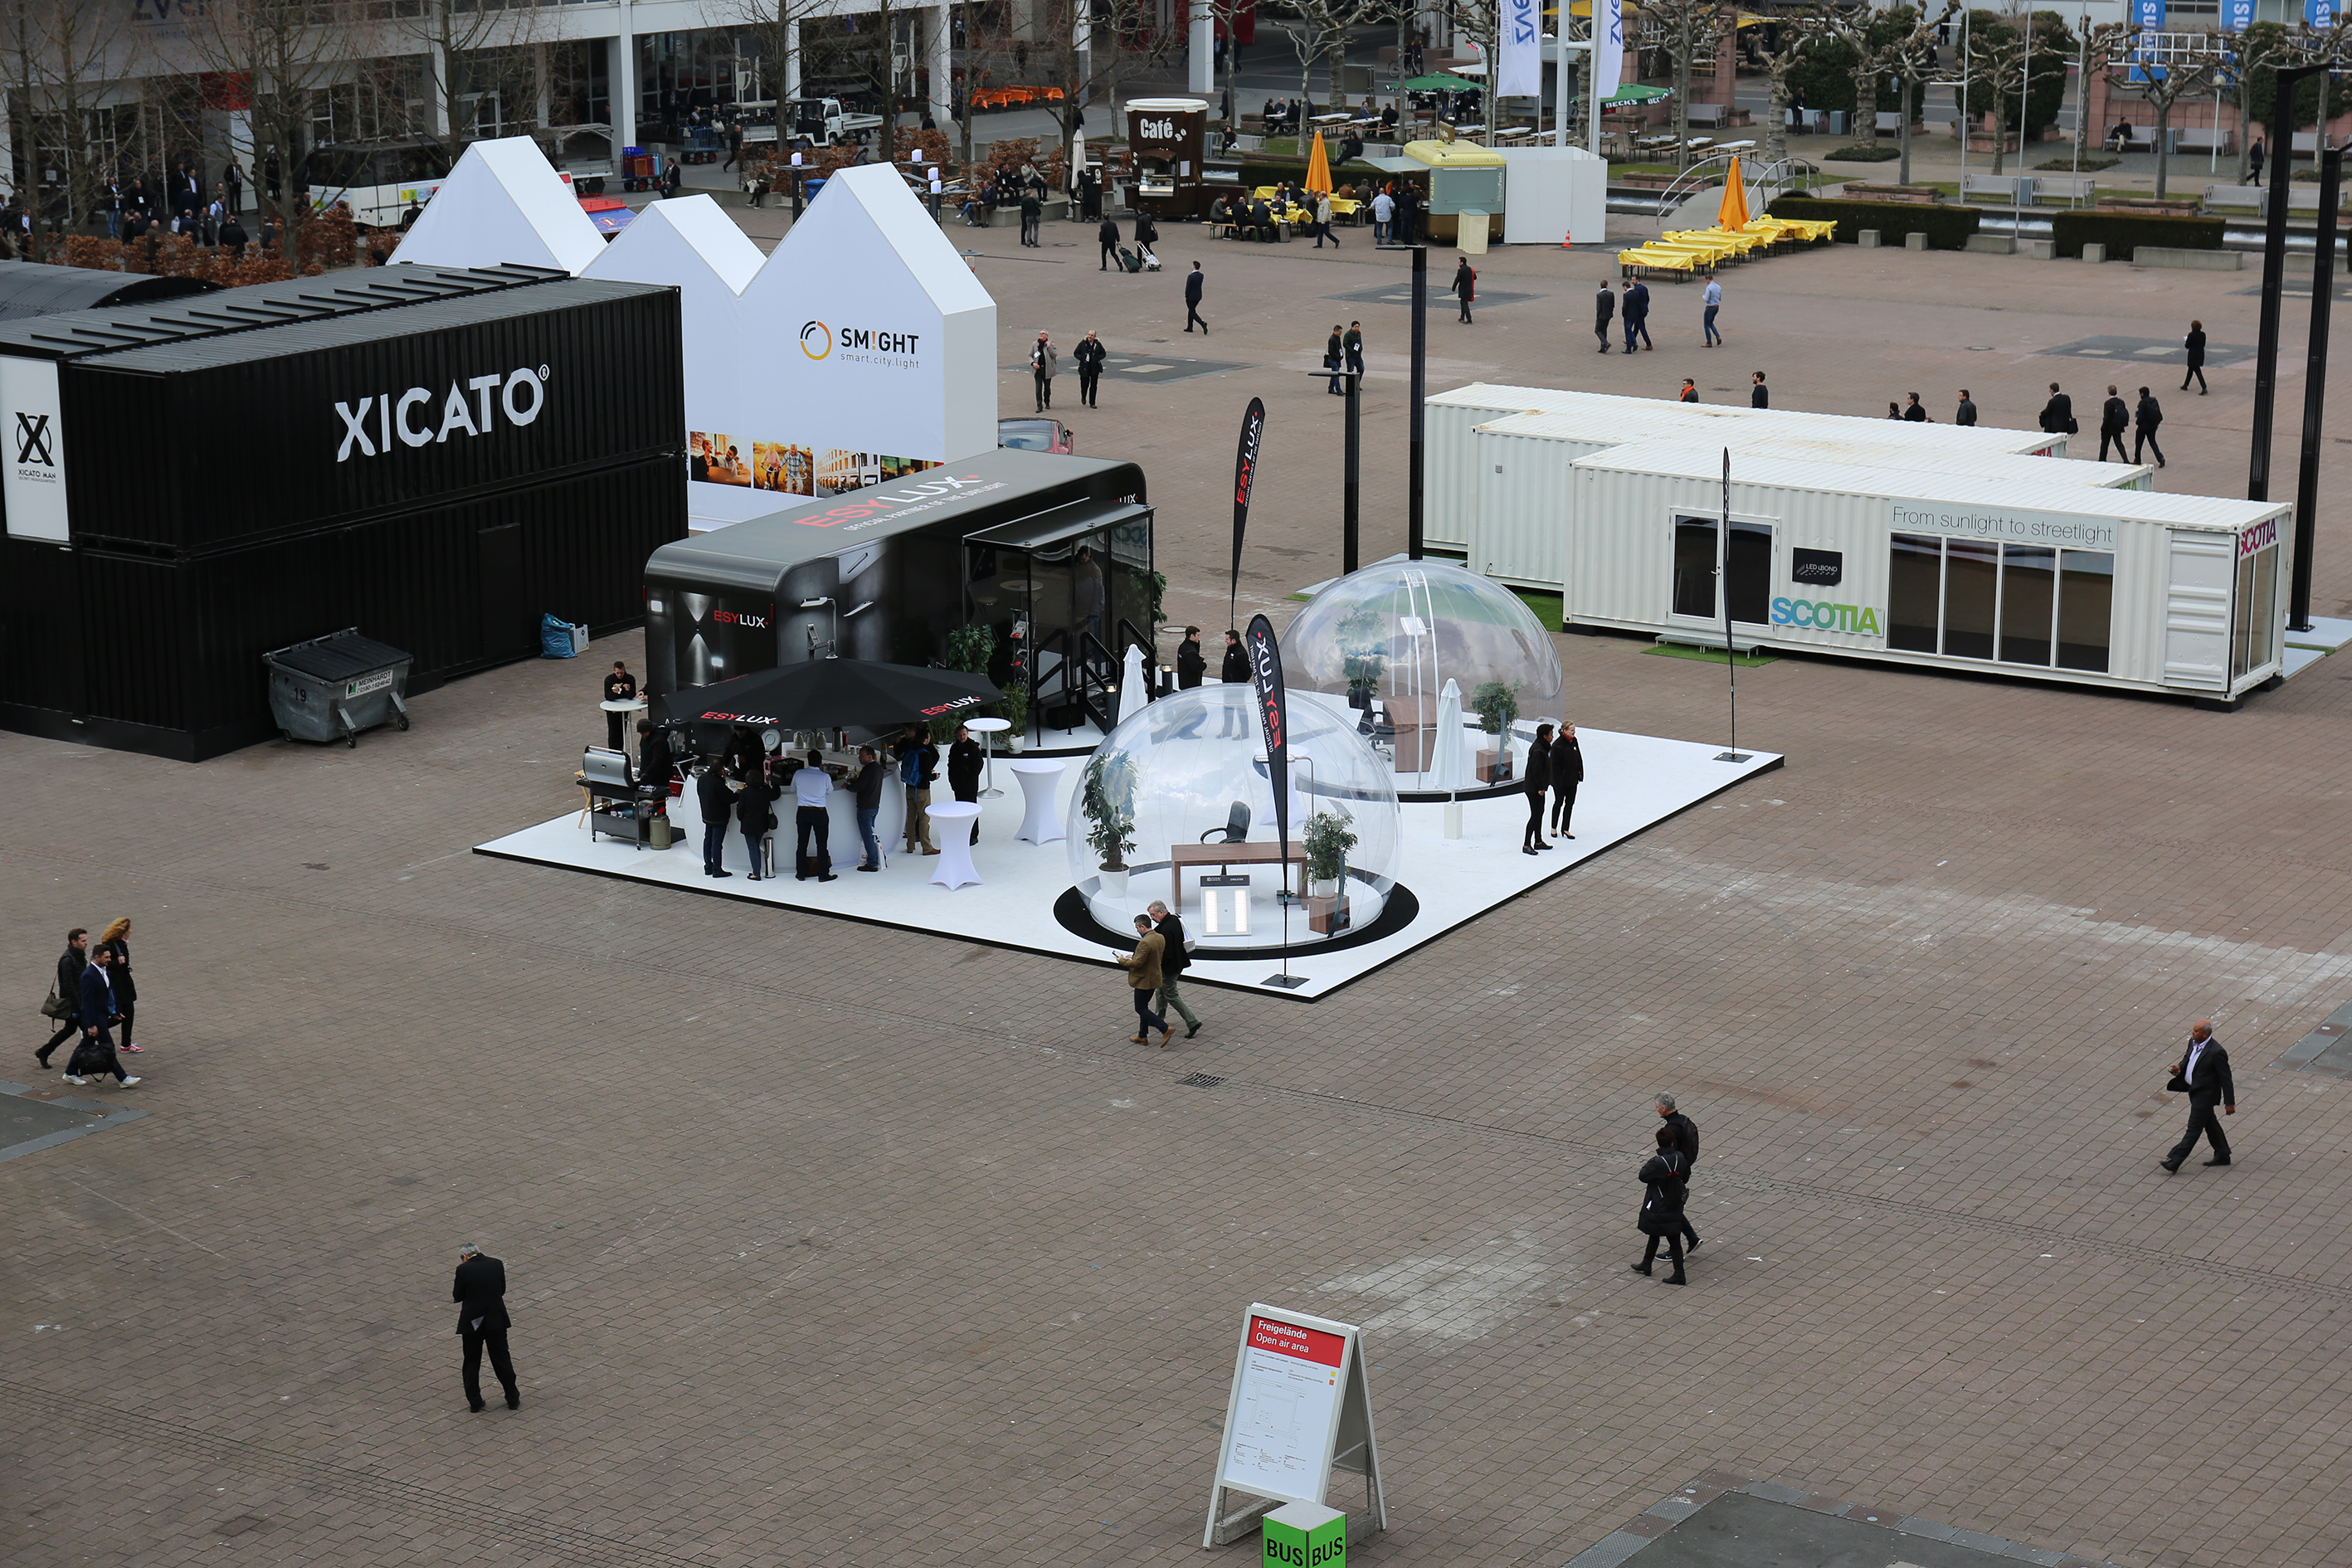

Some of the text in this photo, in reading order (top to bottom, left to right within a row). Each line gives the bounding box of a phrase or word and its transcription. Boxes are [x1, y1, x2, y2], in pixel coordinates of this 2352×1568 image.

[1140, 118, 1173, 139] Café
[840, 328, 919, 354] SM!GHT
[840, 353, 919, 370] smart.city.light
[1236, 415, 1259, 504] ESYLUX
[17, 468, 40, 478] XICATO
[792, 475, 984, 528] ESYLUX
[1892, 506, 2113, 545] From sunlight to streetlight
[713, 610, 766, 629] ESYLUX
[358, 670, 392, 687] MEINHARDT
[294, 687, 307, 703] 19
[920, 695, 981, 716] ESYLUX
[700, 711, 777, 724] ESYLUX
[1258, 1320, 1307, 1340] Freigelände
[1256, 1332, 1309, 1353] Open air area
[1267, 1537, 1303, 1567] BUS
[1312, 1536, 1343, 1568] BUS
